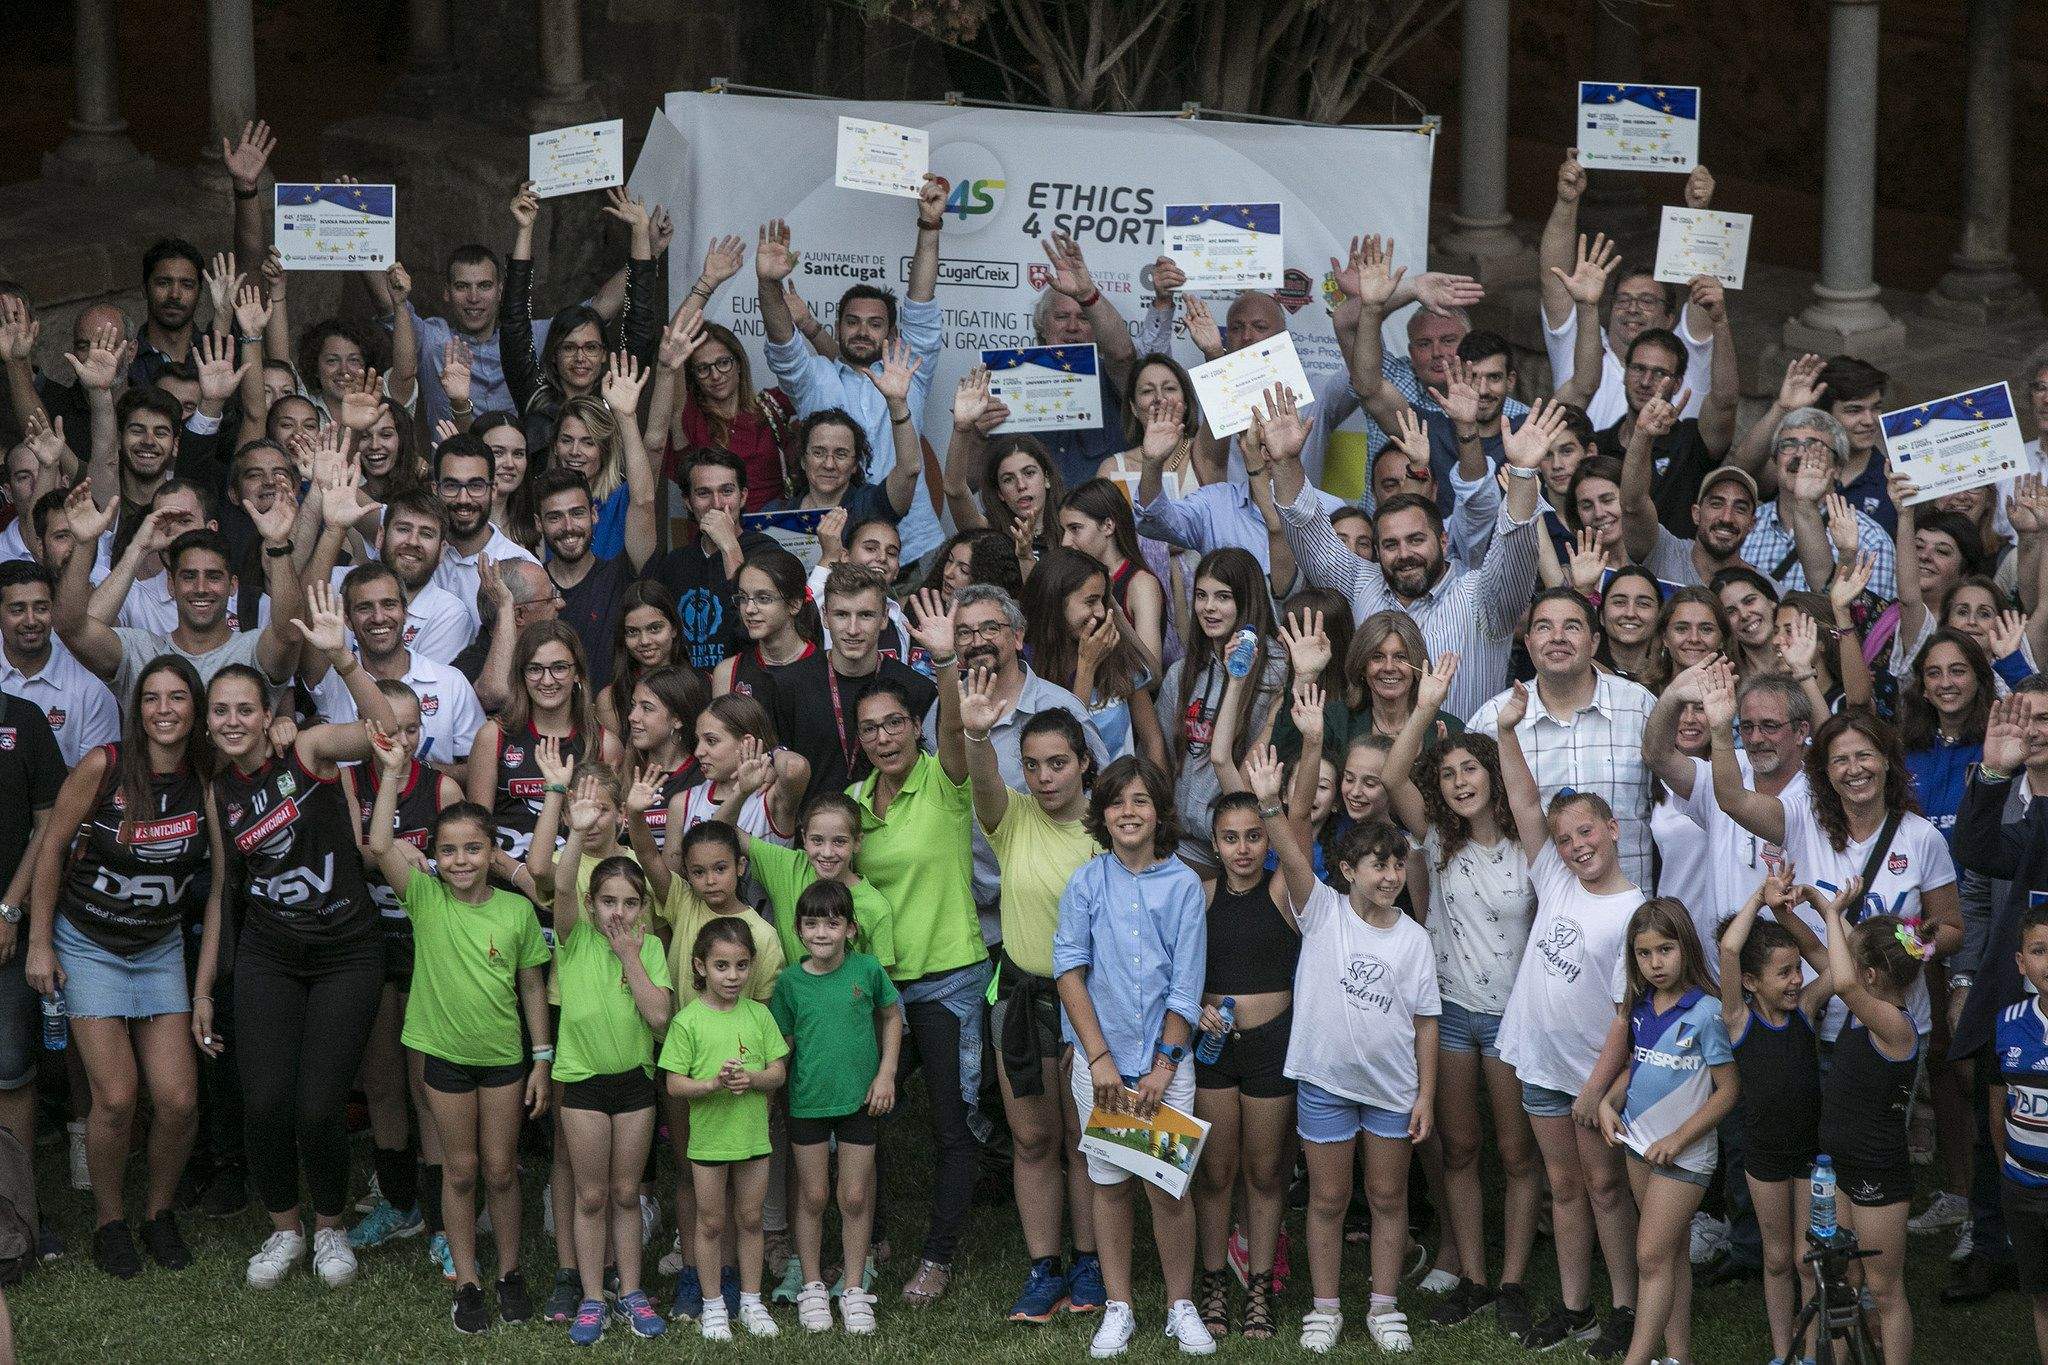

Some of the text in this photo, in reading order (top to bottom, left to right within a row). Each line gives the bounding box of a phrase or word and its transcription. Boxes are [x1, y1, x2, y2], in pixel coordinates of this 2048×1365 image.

[1028, 182, 1154, 215] ETHICS
[1022, 212, 1165, 245] 4 SPORT
[804, 252, 886, 265] AJUNTAMENT DE
[804, 261, 886, 281] SantCugat
[906, 261, 1010, 284] SCugatCreix
[732, 319, 765, 337] AND
[92, 865, 195, 907] DSV
[1633, 1044, 1702, 1070] TERSPORT
[2019, 1090, 2048, 1117] BD
